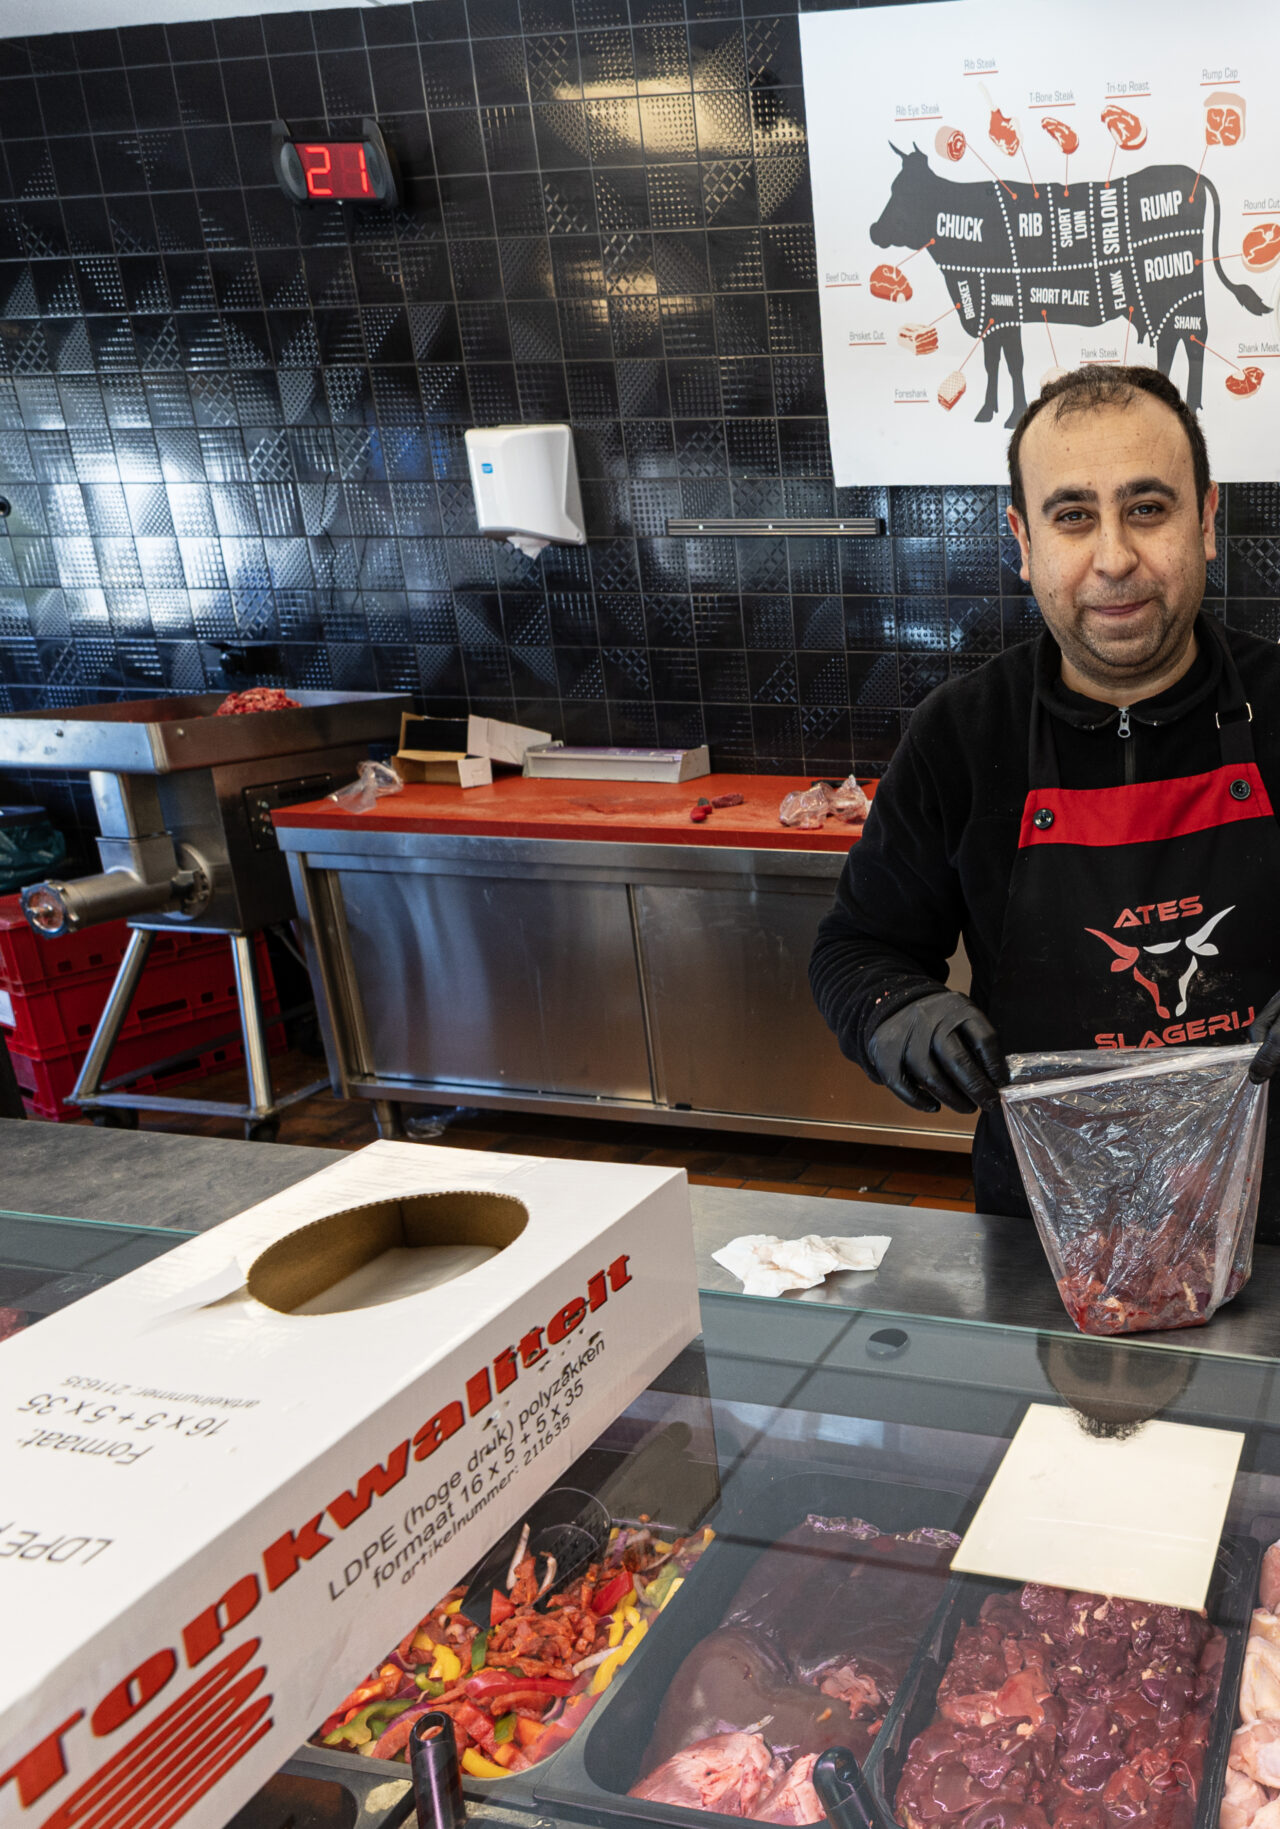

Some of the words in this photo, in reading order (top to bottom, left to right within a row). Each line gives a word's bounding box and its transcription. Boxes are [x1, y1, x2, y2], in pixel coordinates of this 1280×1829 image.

[964, 59, 975, 71] Rib
[977, 57, 997, 70] Steak
[1202, 69, 1222, 82] Rump
[1224, 67, 1239, 80] Cap
[1029, 91, 1054, 104] T-Bone
[1055, 90, 1075, 102] Steak
[1106, 81, 1127, 94] Tri-tip
[1129, 80, 1150, 92] Roast
[896, 105, 906, 116] Rib
[908, 105, 919, 117] Eye
[921, 104, 940, 115] Steak
[305, 146, 370, 196] 21
[1140, 190, 1183, 222] RUMP
[1243, 199, 1266, 210] Round
[1268, 198, 1280, 209] Cut
[936, 212, 984, 242] CHUCK
[1018, 213, 1043, 237] RIB
[1058, 207, 1074, 248] SHORT
[1073, 210, 1088, 240] LOIN
[1100, 188, 1120, 255] SIRLOIN
[825, 273, 839, 283] Beef
[840, 272, 860, 282] Chuck
[1144, 250, 1194, 283] ROUND
[957, 280, 976, 320] BRISKET
[991, 294, 1014, 307] SHANK
[1030, 287, 1060, 304] SHORT
[1061, 289, 1090, 306] PLATE
[1109, 270, 1127, 311] FLANK
[1174, 315, 1202, 331] SHANK
[849, 331, 872, 341] Brisket
[873, 331, 886, 341] Cut
[1080, 348, 1098, 359] Flank
[1099, 347, 1118, 358] Steak
[1238, 343, 1260, 354] Shank
[1261, 342, 1280, 353] Meat
[894, 388, 928, 398] Foreshank
[1113, 895, 1204, 929] ATES
[1094, 1006, 1256, 1050] SLAGERIJ
[61, 1374, 131, 1396] 211635
[17, 1393, 69, 1415] 35
[65, 1400, 95, 1416] x
[82, 1404, 117, 1424] 5
[117, 1412, 137, 1424] +
[134, 1411, 168, 1431] 5
[165, 1414, 194, 1430] x
[184, 1416, 230, 1438] 16
[328, 1525, 399, 1602] LDPE
[403, 1470, 463, 1535] (hoge
[466, 1419, 515, 1474] druk)
[517, 1338, 606, 1431] polyzakken
[372, 1502, 455, 1590] formaat
[460, 1473, 484, 1504] 16
[488, 1460, 500, 1477] x
[504, 1442, 516, 1464] 5
[520, 1430, 532, 1445] +
[535, 1413, 548, 1436] 5
[551, 1404, 562, 1422] x
[565, 1378, 585, 1408] 35
[400, 1464, 520, 1586] artikelnummer:
[522, 1412, 571, 1467] 211635
[0, 1254, 633, 1811] Topkwaliteit
[0, 1531, 114, 1566] LDPE
